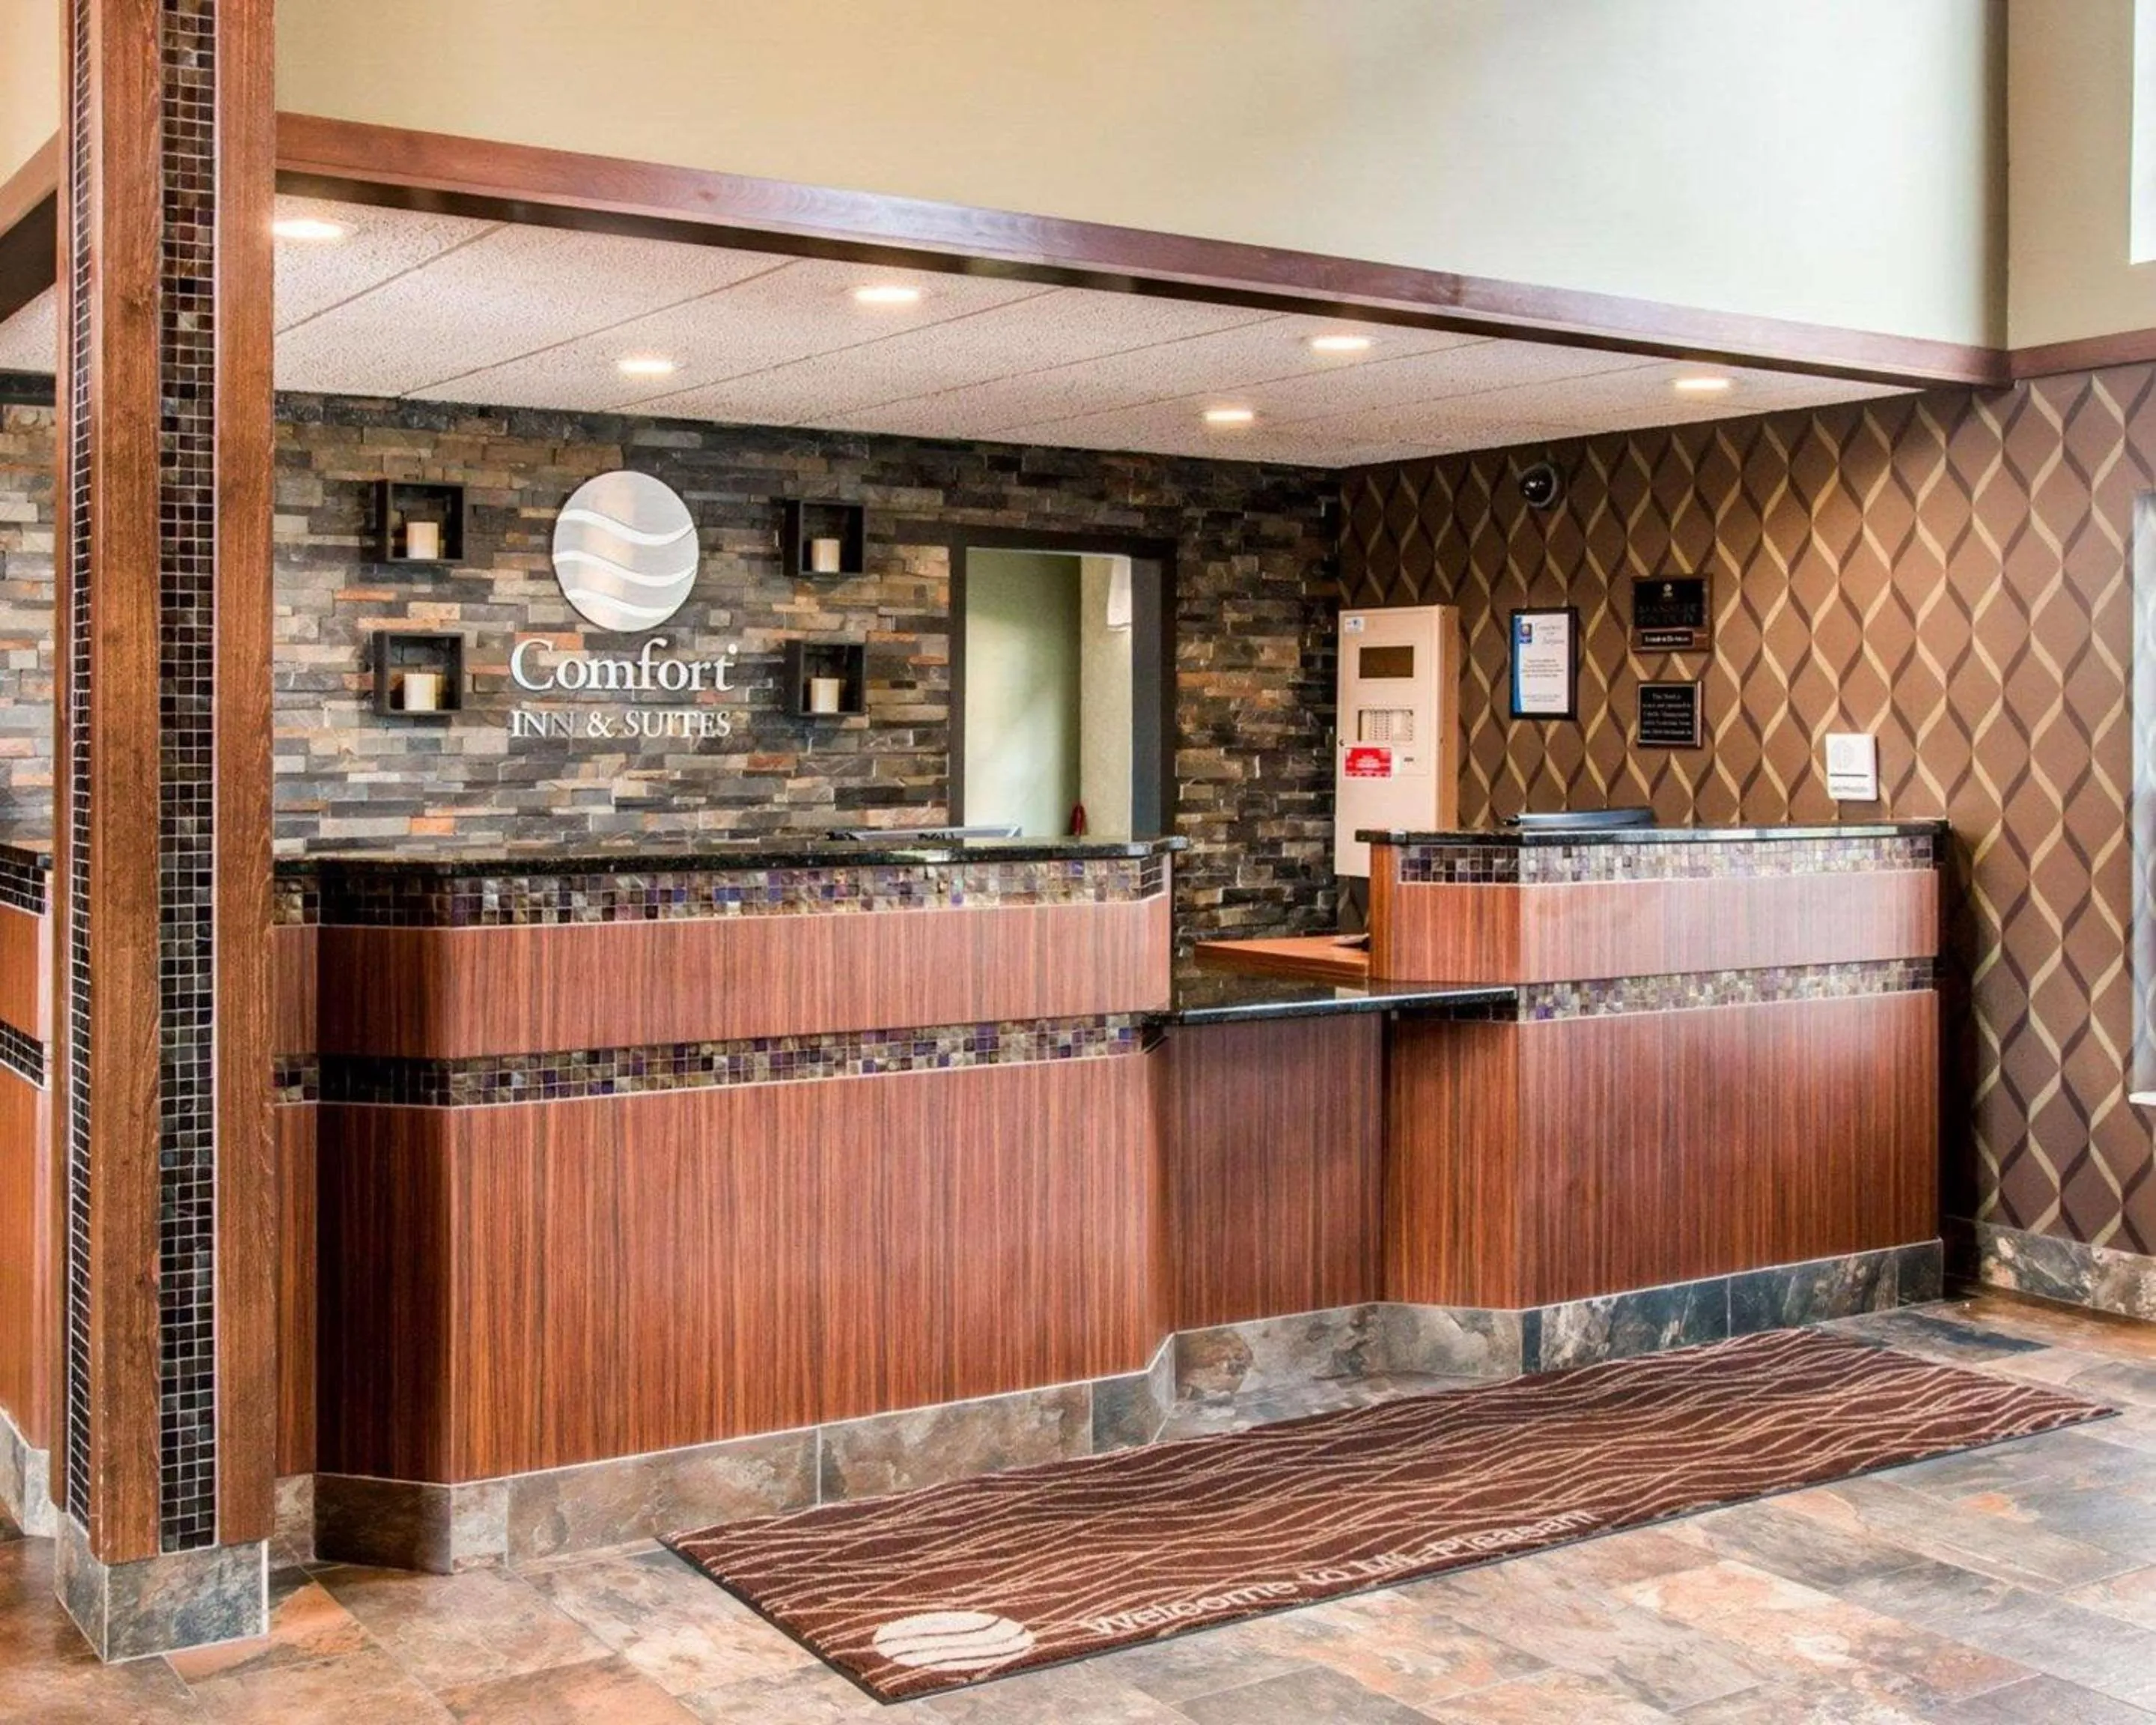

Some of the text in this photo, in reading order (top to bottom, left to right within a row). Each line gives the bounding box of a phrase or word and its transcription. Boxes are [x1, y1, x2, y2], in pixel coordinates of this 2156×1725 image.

[511, 636, 737, 692] Comfort
[511, 710, 731, 738] INN & SUITES
[1077, 1581, 1299, 1635] Welcome
[1298, 1569, 1352, 1586] to
